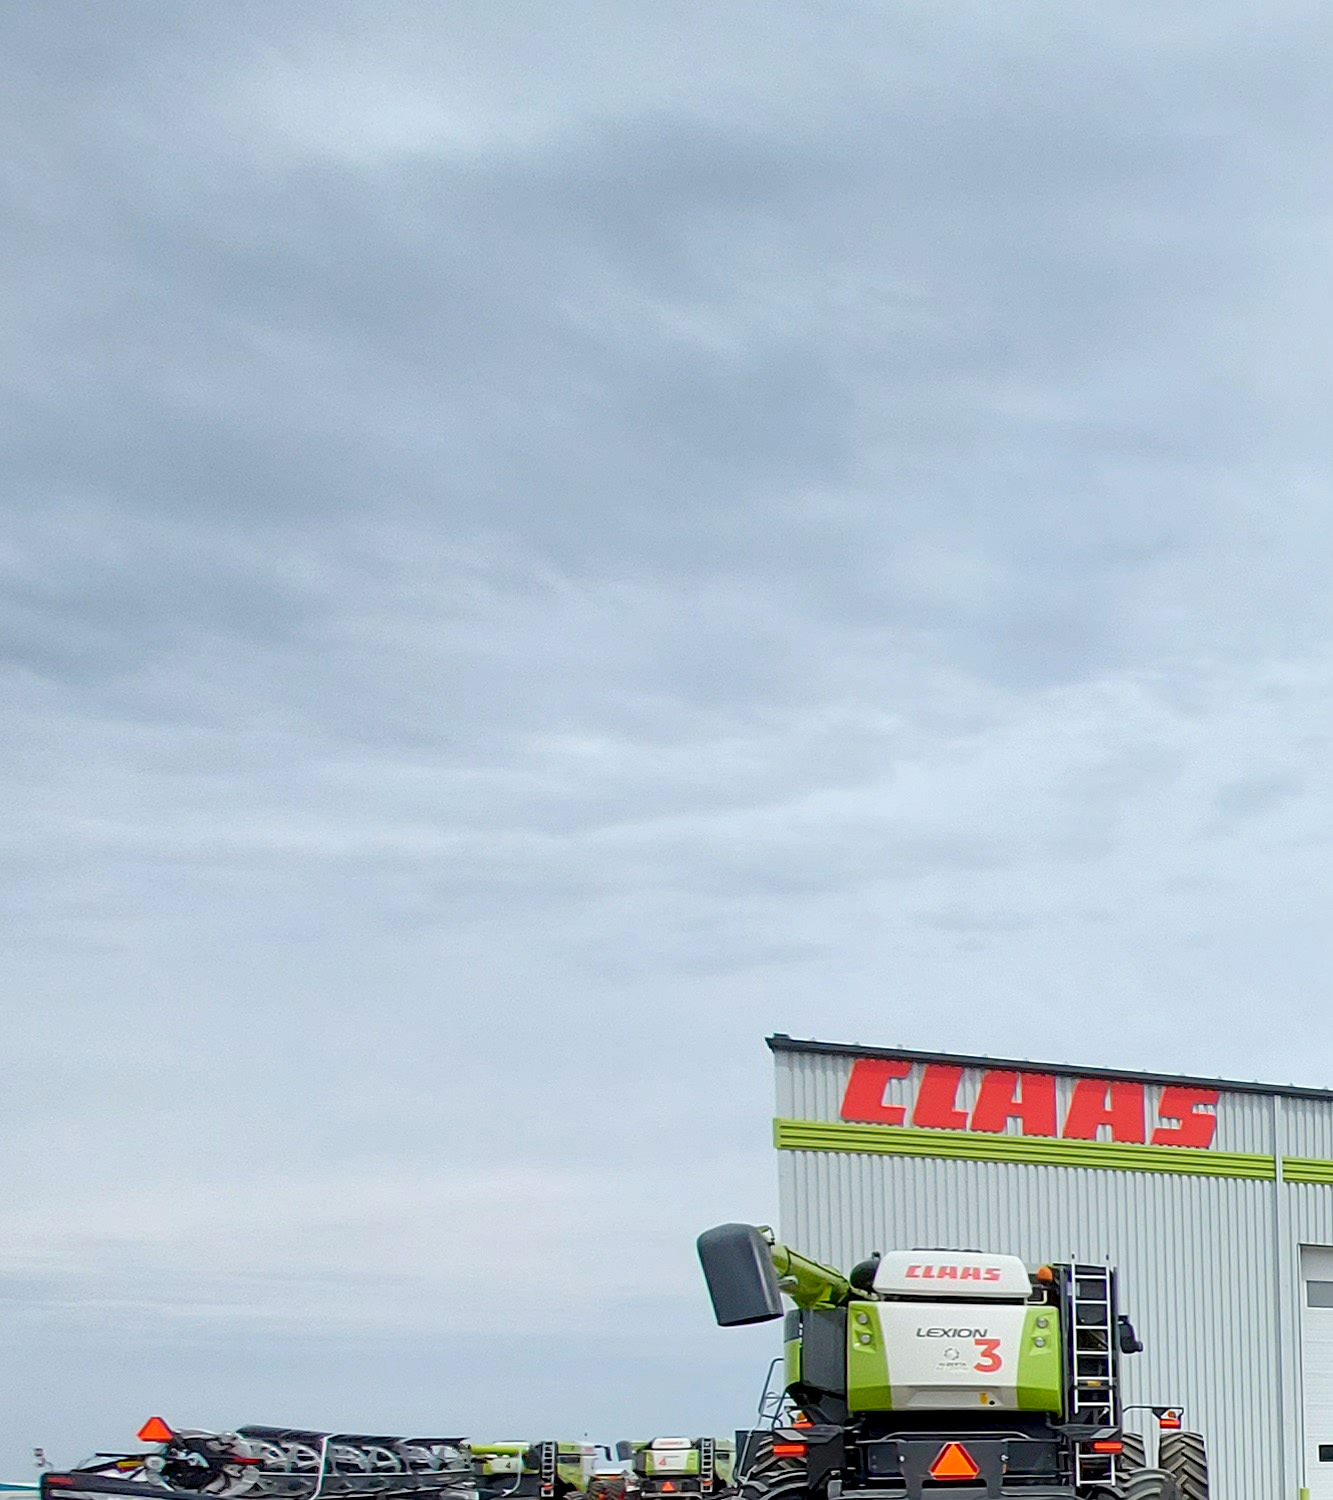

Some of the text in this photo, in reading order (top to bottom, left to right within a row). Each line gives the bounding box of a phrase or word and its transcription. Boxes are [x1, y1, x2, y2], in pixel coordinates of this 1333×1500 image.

[841, 1058, 1219, 1150] CLAAS
[905, 1264, 1002, 1281] CLAAS
[916, 1327, 988, 1338] LEXION
[973, 1338, 1003, 1373] 3
